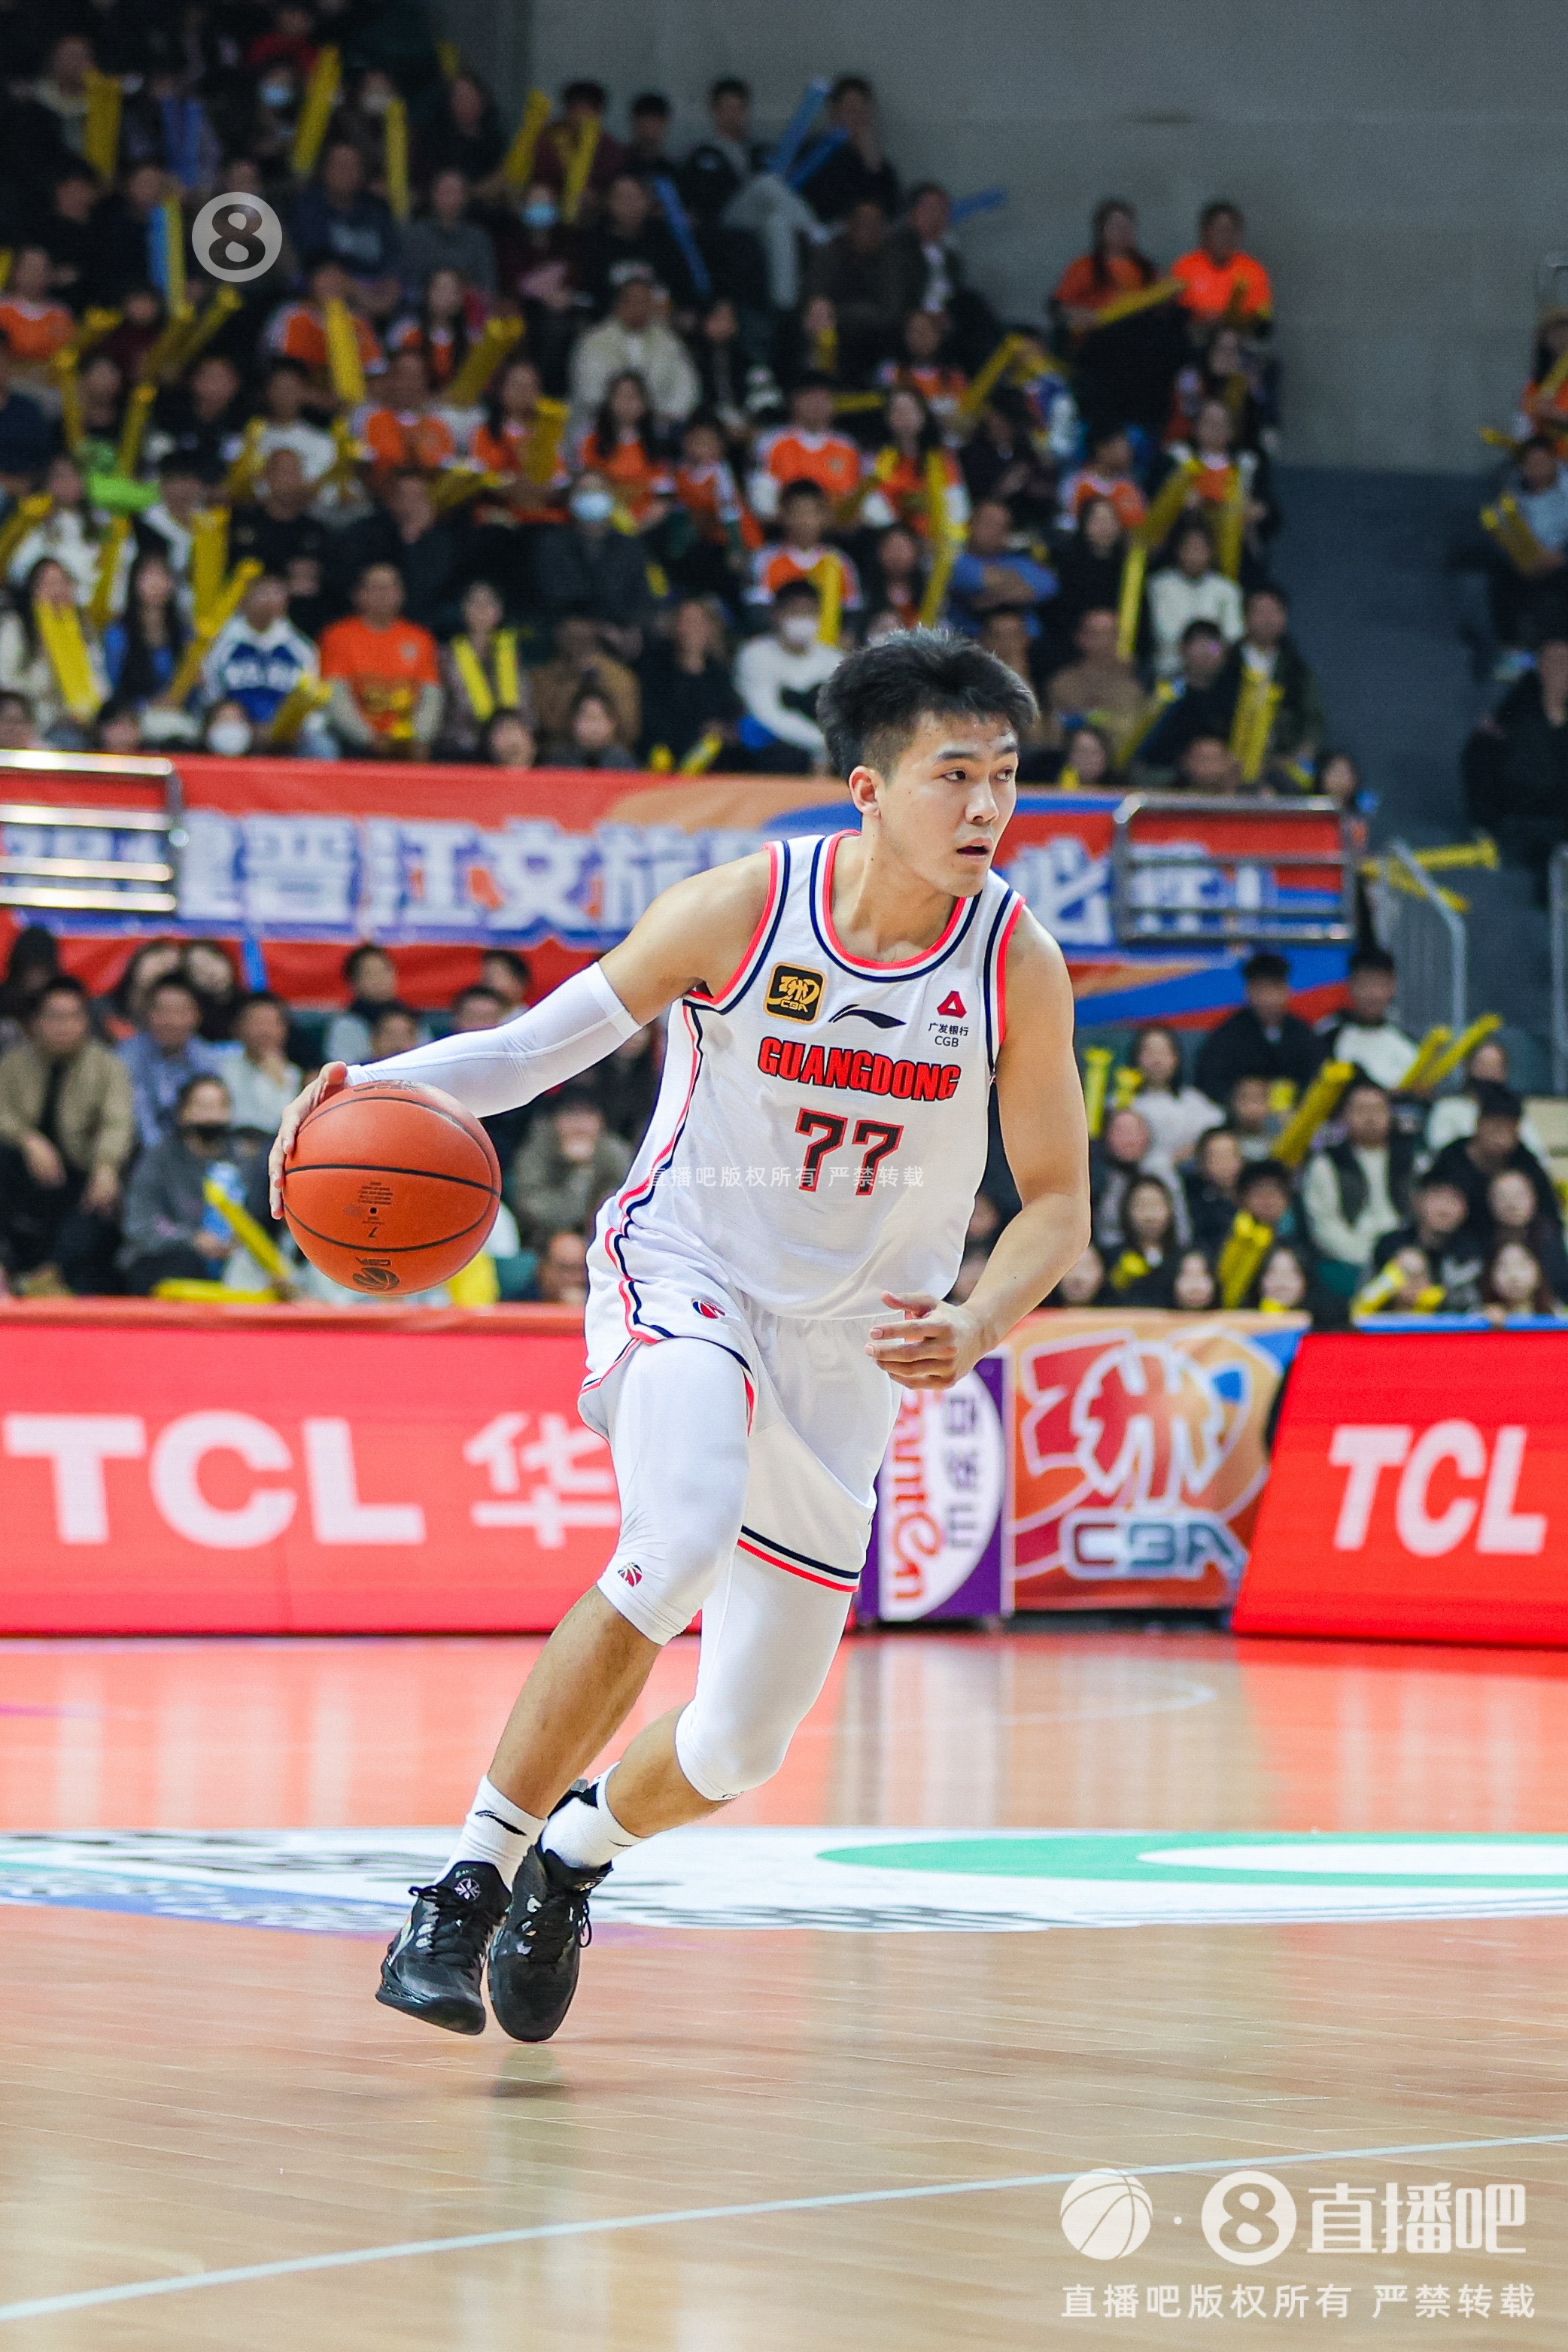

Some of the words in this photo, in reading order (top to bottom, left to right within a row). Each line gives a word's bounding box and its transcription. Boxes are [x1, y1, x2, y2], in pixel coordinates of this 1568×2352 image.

[780, 999, 809, 1013] CBA
[928, 1022, 970, 1037] 广发银行
[758, 1036, 962, 1102] GUANGDONG
[934, 1035, 960, 1048] CGB
[795, 1108, 904, 1196] 77
[4, 1408, 426, 1549] TCL
[1328, 1418, 1548, 1557] TCL
[1067, 1512, 1243, 1574] CBA
